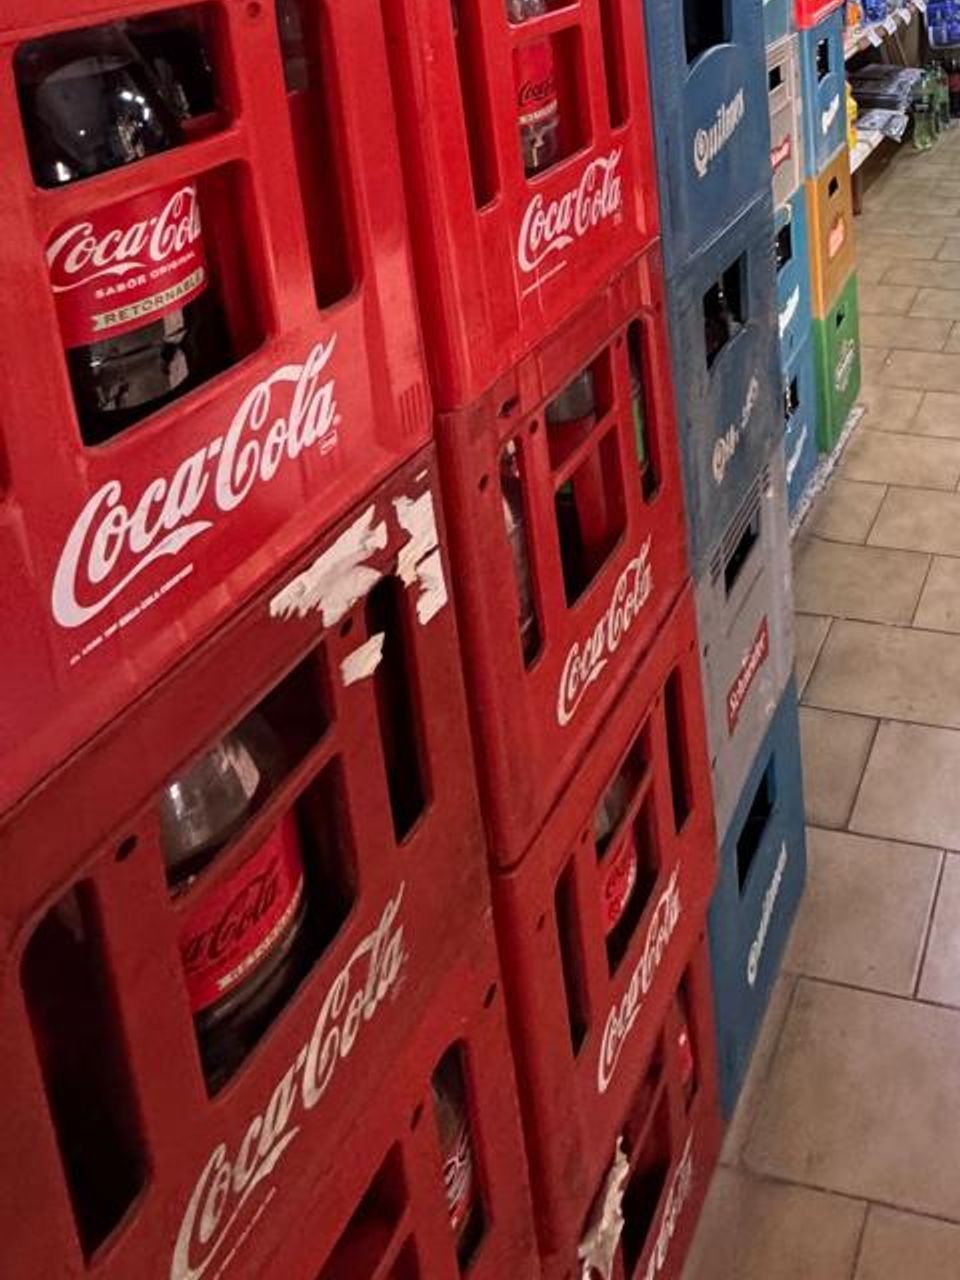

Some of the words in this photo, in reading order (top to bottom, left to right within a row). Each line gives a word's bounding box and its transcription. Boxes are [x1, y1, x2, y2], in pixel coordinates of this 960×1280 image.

[46, 186, 201, 293] Coca-Col
[95, 273, 147, 299] SABOR
[518, 144, 623, 273] Coca-Cola
[52, 332, 338, 628] Coca-Cola
[557, 533, 652, 726] Coca-Cola
[598, 858, 682, 1094] Coca-Cola
[169, 880, 407, 1280] Coca-Cola
